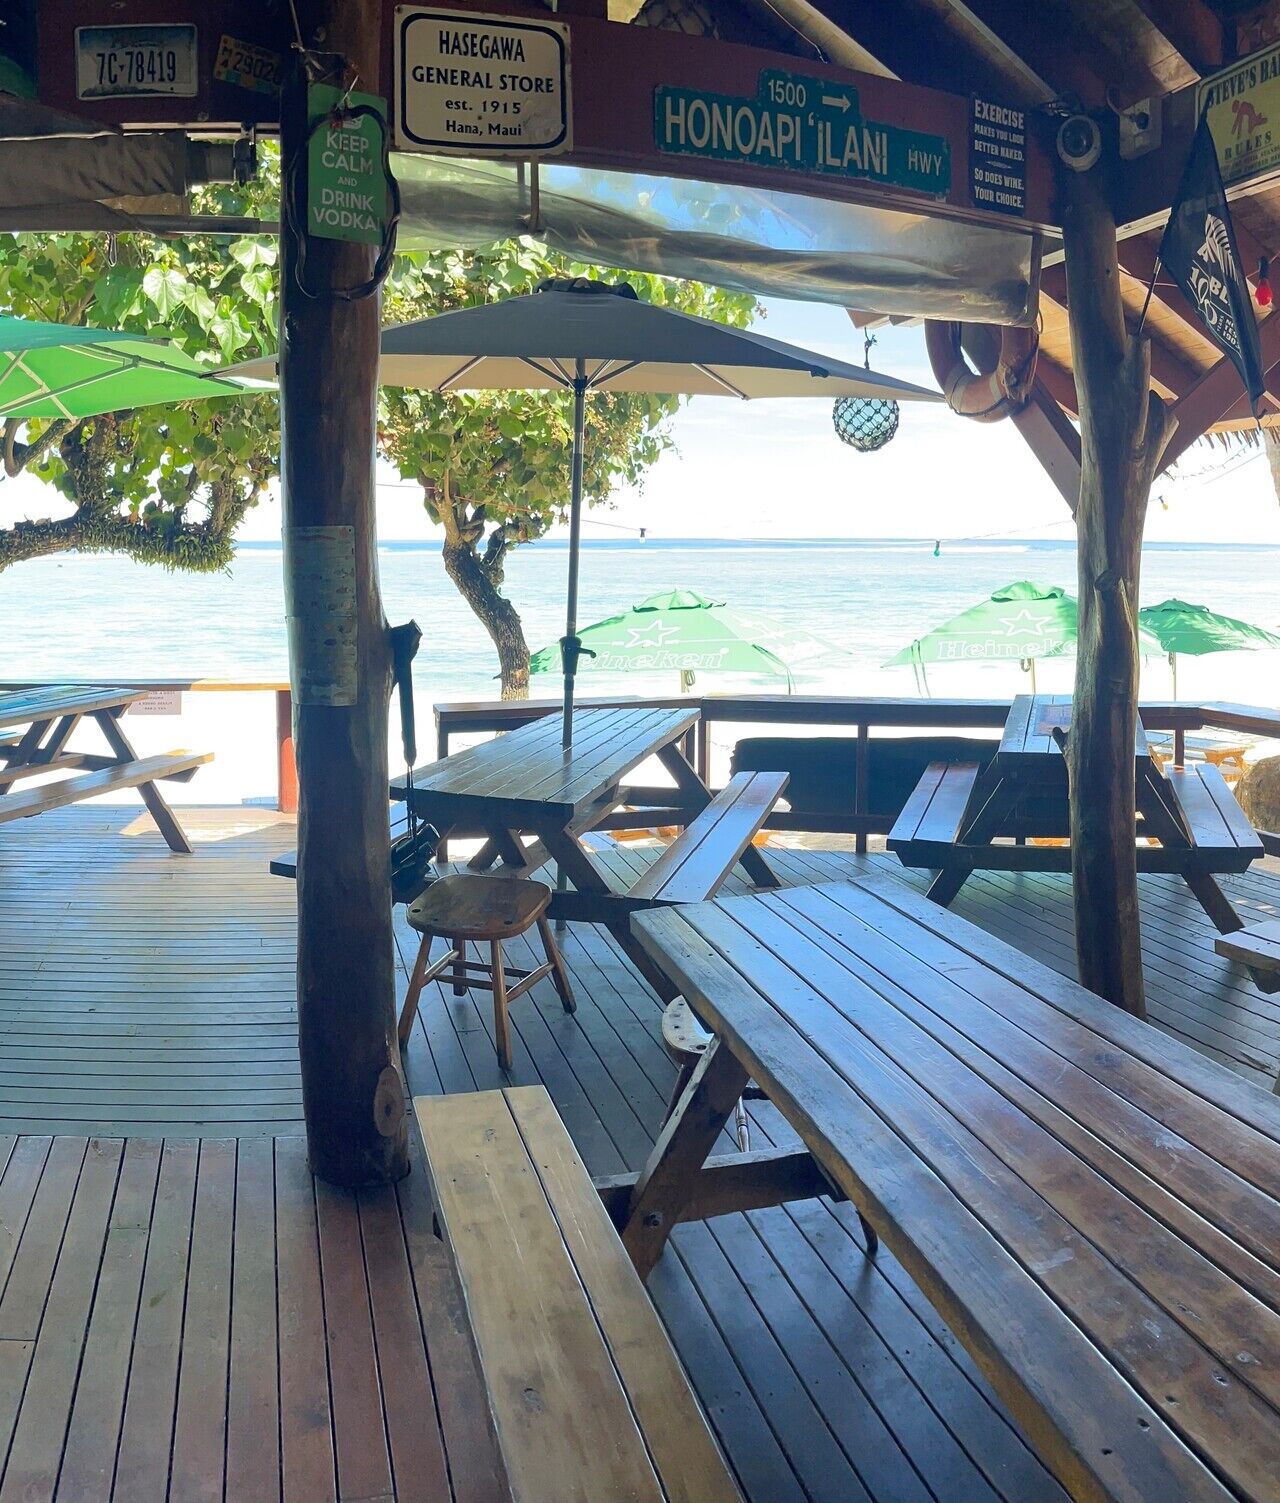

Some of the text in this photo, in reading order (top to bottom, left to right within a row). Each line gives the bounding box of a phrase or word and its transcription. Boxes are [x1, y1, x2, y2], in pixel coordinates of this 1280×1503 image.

[439, 30, 526, 62] HASEGAWA
[97, 50, 177, 85] 7C 78419
[412, 65, 554, 93] GENERAL STORE
[768, 78, 807, 108] 1500
[445, 99, 521, 114] est. 1915
[974, 99, 1025, 130] EXERCISE
[446, 119, 522, 136] Hana, Maui
[974, 123, 1024, 146] MAKES YOU LOOK
[326, 131, 369, 154] KEEP
[974, 139, 999, 156] BETTER
[1224, 131, 1272, 161] RULES
[321, 151, 373, 175] CALM
[908, 148, 942, 177] HWY
[337, 176, 358, 188] AND
[974, 168, 1025, 191] SO DOES WINE.
[321, 188, 374, 212] DRINK
[974, 185, 1025, 209] YOUR CHOICE.
